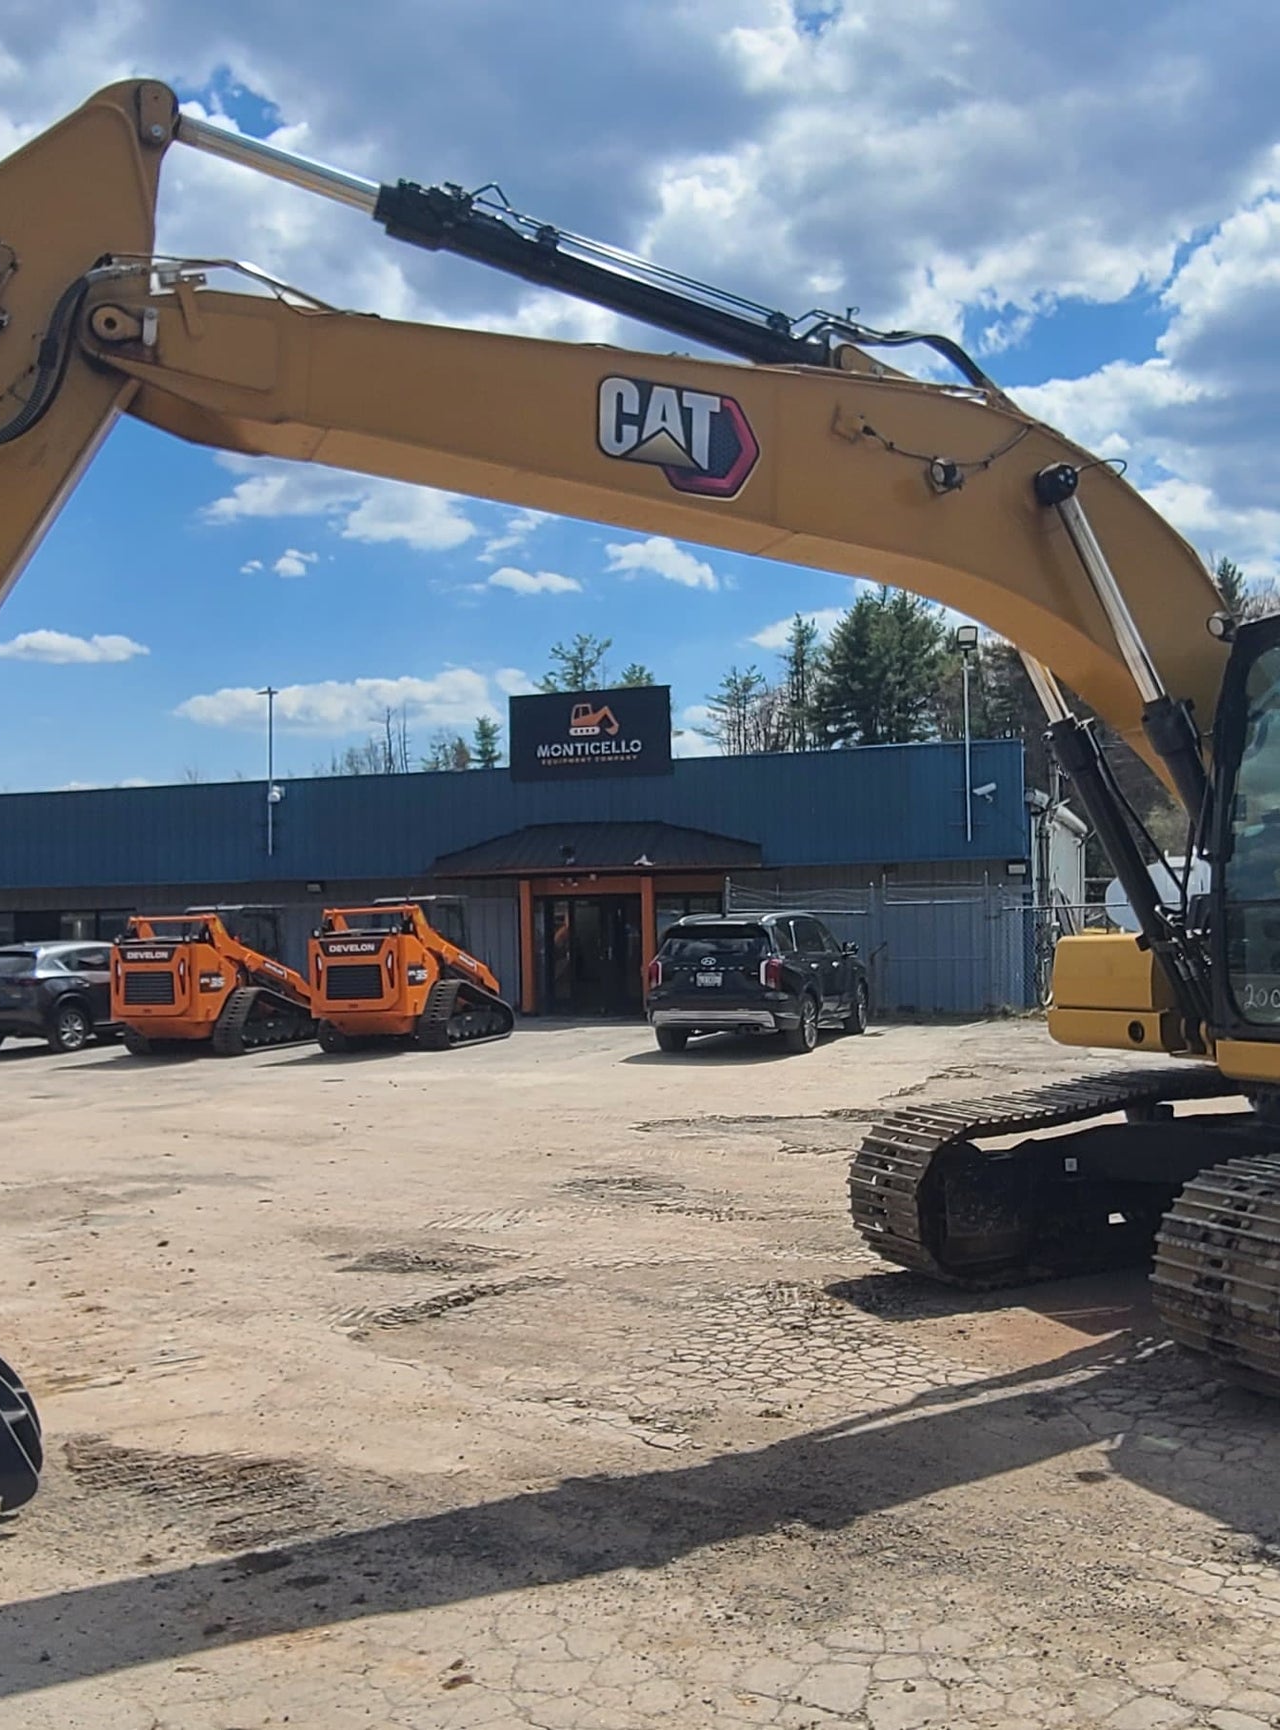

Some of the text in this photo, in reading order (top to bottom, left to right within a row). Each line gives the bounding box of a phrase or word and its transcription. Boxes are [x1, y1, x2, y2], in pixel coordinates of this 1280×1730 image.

[599, 377, 720, 470] CAT
[537, 739, 642, 758] MONTICELLO
[328, 943, 375, 953] DEVELON
[126, 951, 168, 960] DEVELON
